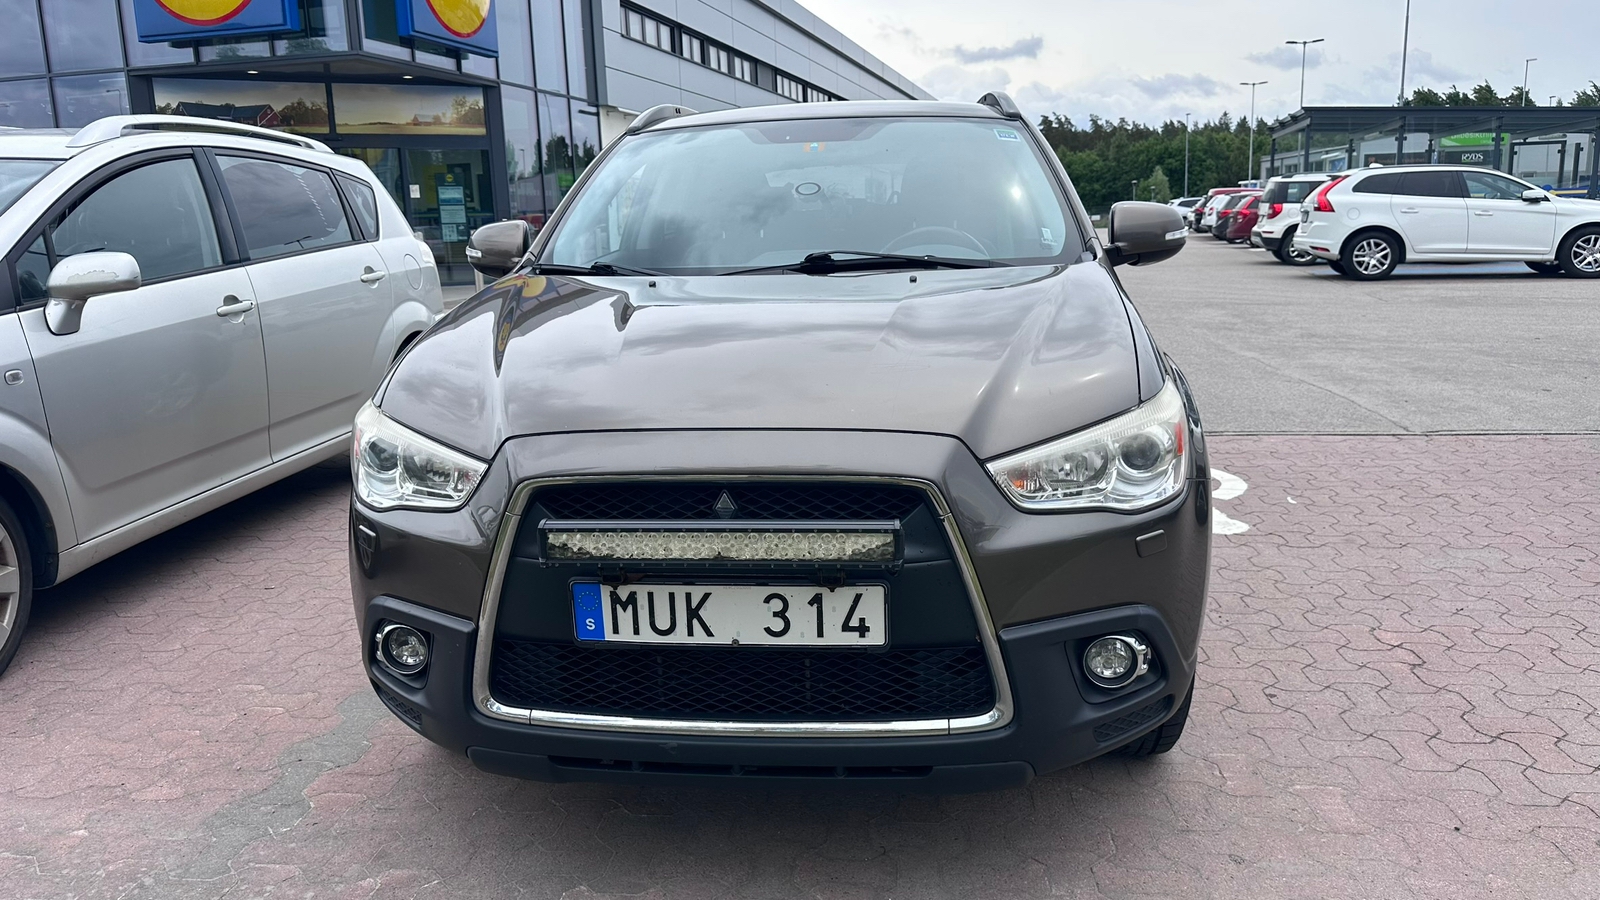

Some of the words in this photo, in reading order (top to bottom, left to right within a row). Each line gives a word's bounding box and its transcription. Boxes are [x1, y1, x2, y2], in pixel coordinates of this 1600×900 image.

[1461, 152, 1484, 161] RYDS
[609, 590, 715, 638] MUK
[762, 592, 871, 639] 314
[585, 618, 596, 630] S
